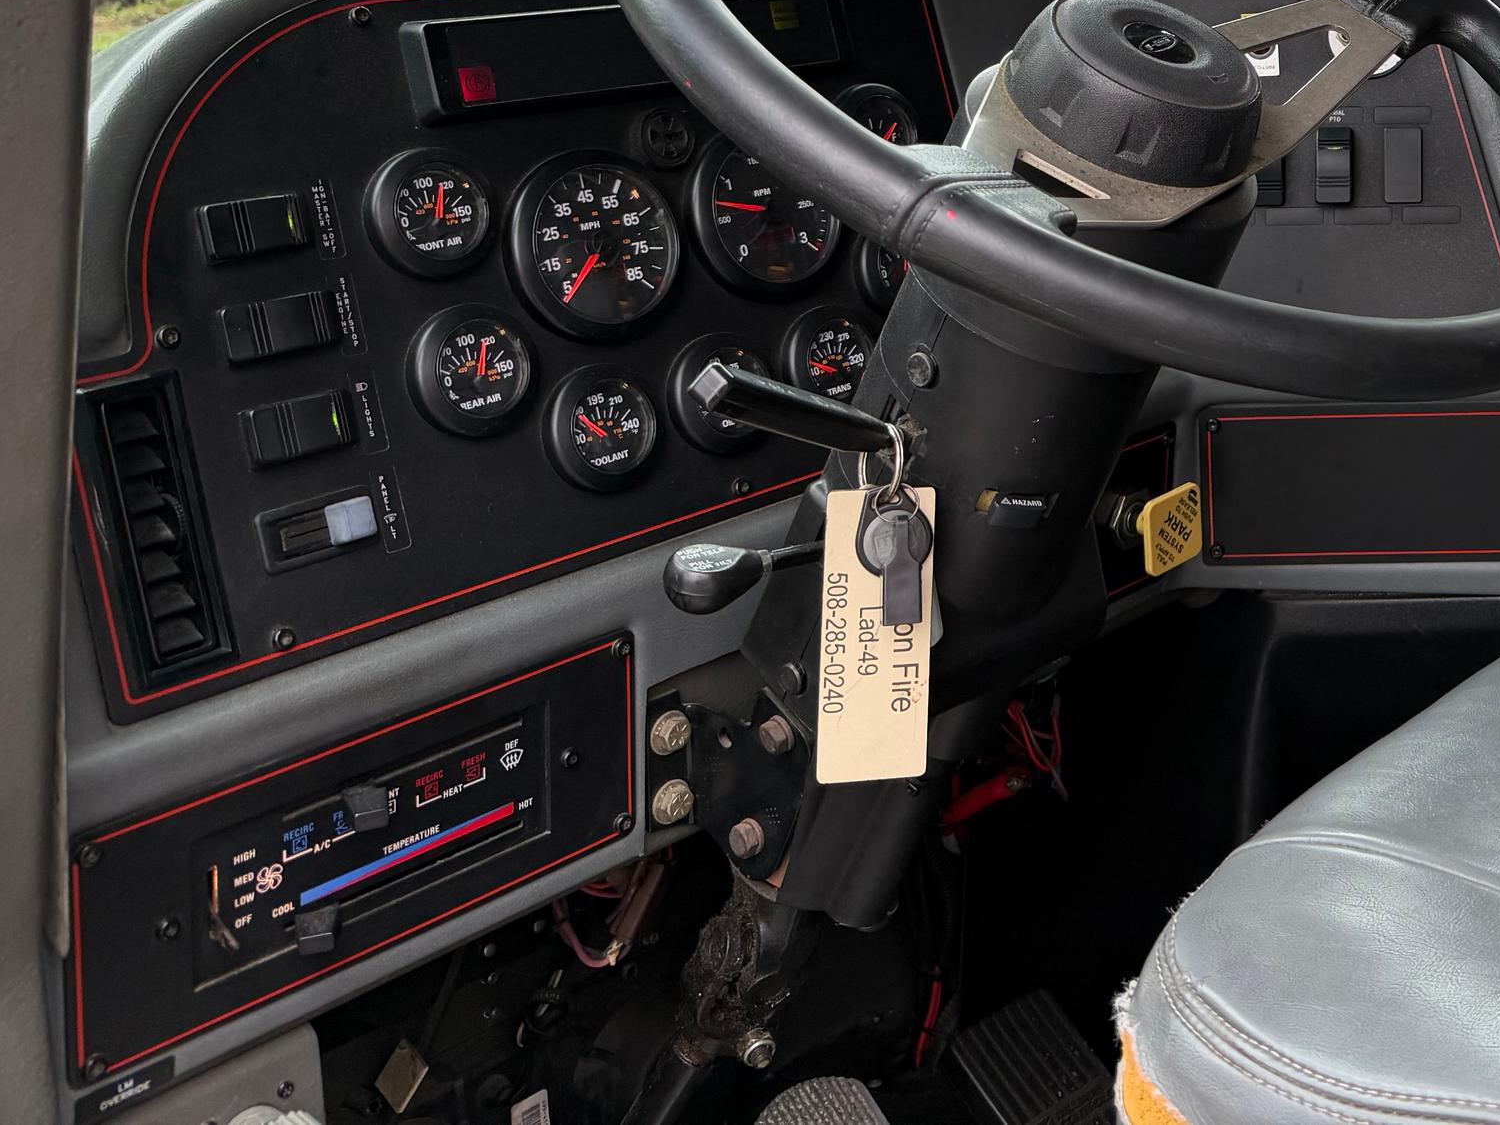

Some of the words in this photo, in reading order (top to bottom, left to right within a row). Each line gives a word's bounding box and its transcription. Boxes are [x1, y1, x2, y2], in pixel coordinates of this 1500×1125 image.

[412, 176, 433, 190] 100
[725, 179, 733, 191] 1
[577, 189, 594, 203] 45
[753, 187, 772, 197] RPM
[601, 195, 619, 209] 55
[311, 186, 325, 226] MASTER
[322, 234, 330, 247] SW
[452, 205, 472, 217] 150
[554, 203, 572, 217] 35
[401, 217, 409, 227] 0
[580, 221, 600, 231] MPH
[623, 212, 639, 226] 65
[718, 216, 732, 225] 500
[542, 227, 560, 241] 25
[800, 232, 808, 244] 3
[447, 236, 463, 247] AIR
[631, 241, 649, 255] 75
[740, 244, 749, 257] 0
[543, 258, 561, 272] 15
[626, 267, 643, 281] 85
[563, 281, 572, 293] 5
[335, 293, 349, 334] ENGINE
[339, 277, 359, 347] START/STOP
[455, 333, 475, 347] 100
[819, 331, 834, 343] 230
[837, 332, 850, 342] 275
[494, 359, 514, 373] 150
[848, 353, 864, 365] 320
[444, 376, 452, 387] 0
[503, 371, 513, 379] psi
[827, 383, 852, 395] TRANS
[460, 397, 485, 410] REAR
[486, 393, 502, 404] AIR
[586, 393, 604, 406] 195
[608, 395, 623, 405] 210
[362, 395, 375, 437] LIGHTS
[622, 417, 640, 431] 240
[378, 475, 392, 511] PANEL
[390, 525, 398, 539] LT
[1012, 499, 1042, 507] HAZARD
[1164, 511, 1192, 541] PARK
[1158, 528, 1184, 553] SYSTEM
[822, 573, 848, 714] 508-285-0240
[857, 606, 884, 676] Lad-49
[891, 663, 920, 713] Fire
[504, 739, 519, 751] DEF
[460, 753, 486, 769] FRESH
[416, 770, 444, 787] RECIRC
[388, 788, 400, 799] NT
[443, 784, 464, 799] HEAT
[518, 797, 534, 811] HOT
[283, 823, 314, 842] RECIRC
[382, 824, 440, 855] TEMPERATURE
[314, 839, 331, 854] A/C
[234, 849, 256, 865] HIGH
[234, 872, 255, 887] MED
[234, 893, 255, 908] LOW
[272, 902, 295, 919] COOL
[234, 914, 252, 929] OFF
